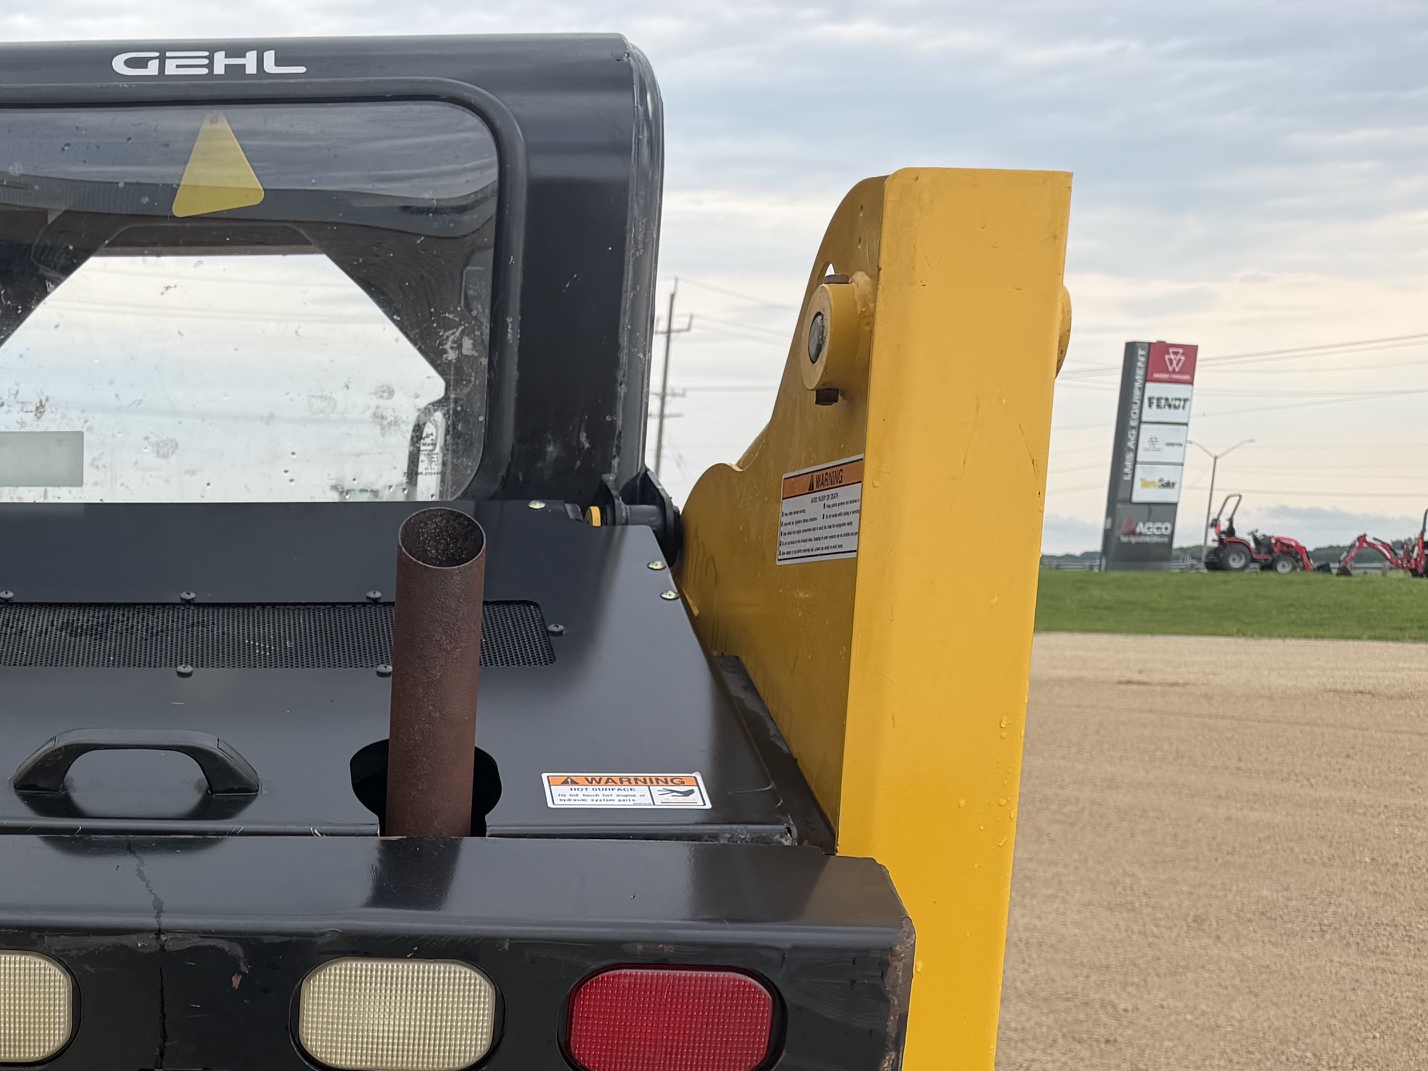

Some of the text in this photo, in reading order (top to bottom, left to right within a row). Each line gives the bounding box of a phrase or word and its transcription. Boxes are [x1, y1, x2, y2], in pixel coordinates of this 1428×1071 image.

[111, 49, 307, 76] GEHL
[1129, 348, 1147, 427] EQUIPMENT
[1147, 396, 1190, 410] FENDT
[1126, 429, 1137, 449] AG
[815, 468, 844, 489] WARNING
[1135, 521, 1172, 535] AGCO
[584, 777, 686, 785] WARNING
